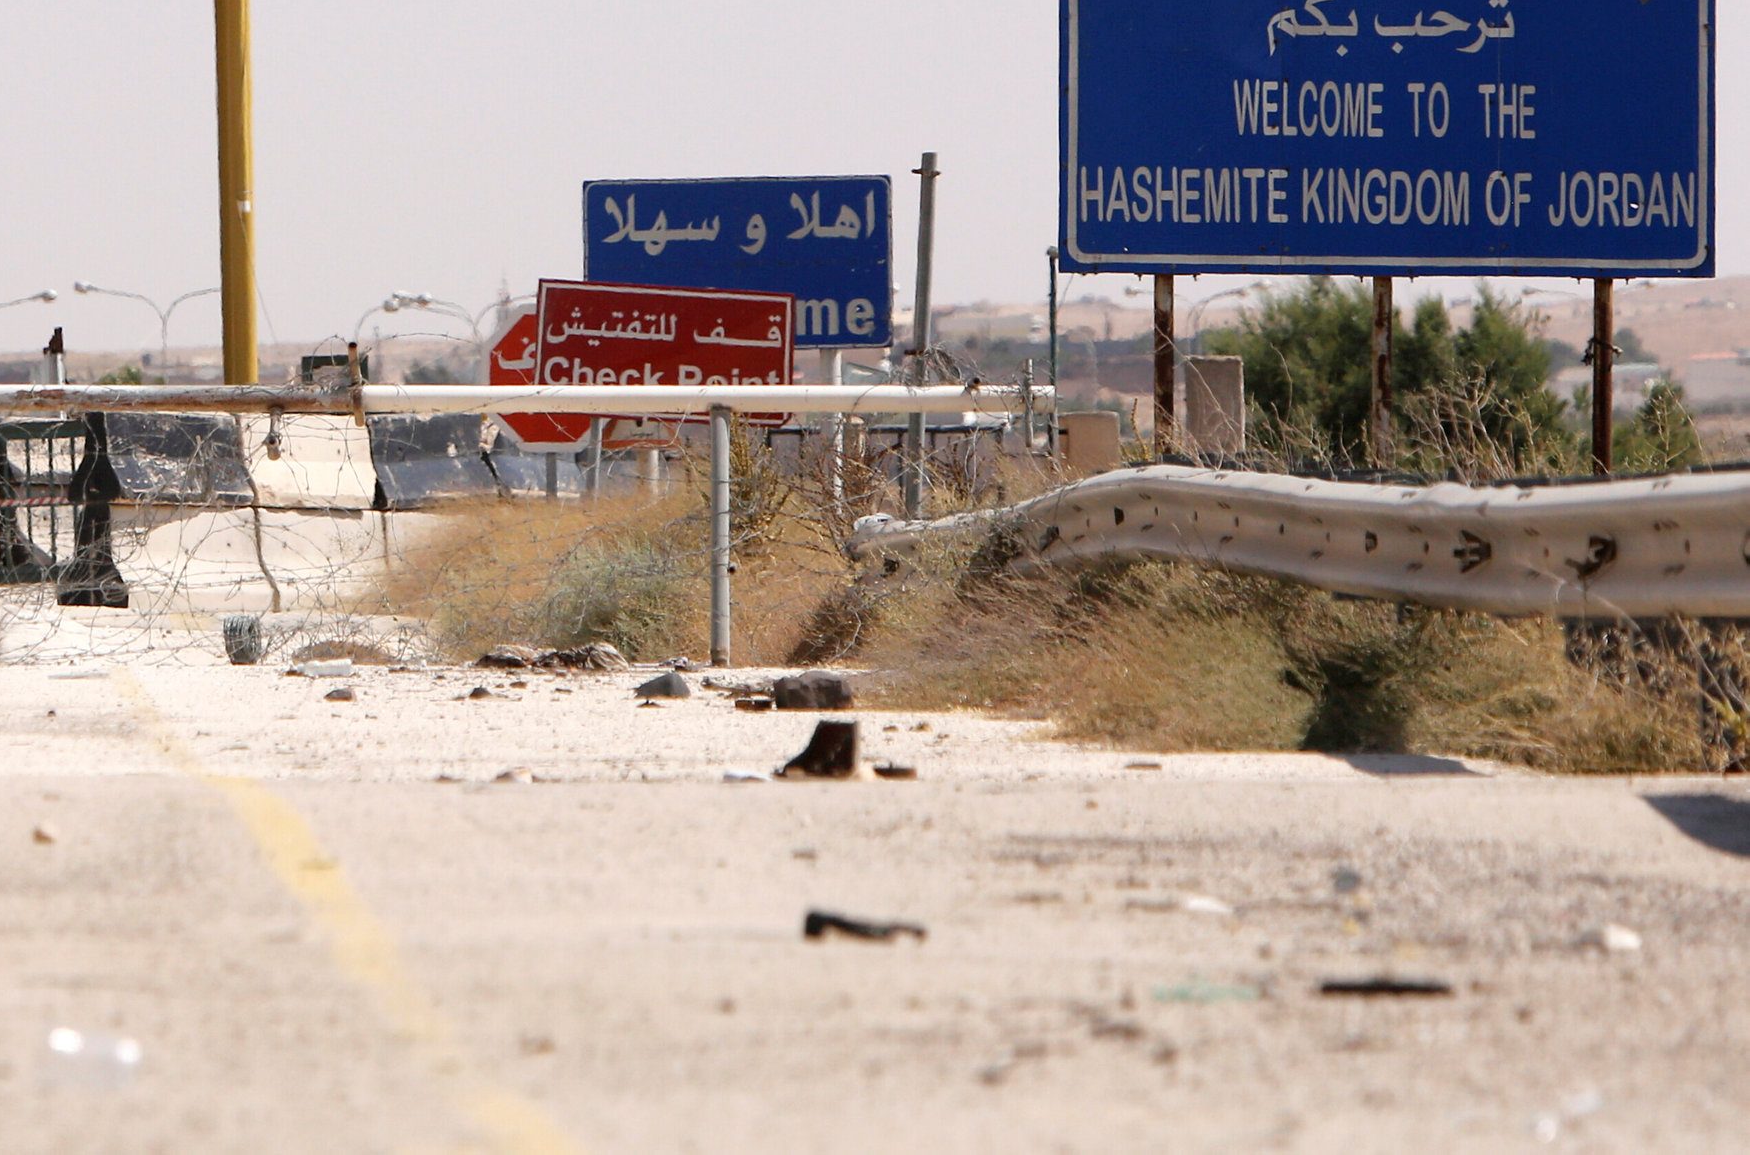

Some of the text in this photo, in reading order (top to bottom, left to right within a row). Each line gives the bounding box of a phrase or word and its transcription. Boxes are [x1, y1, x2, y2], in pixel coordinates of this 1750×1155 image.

[1233, 79, 1536, 139] WELCOME TO THE
[1080, 166, 1696, 228] HASHEMITE KINGDOM OF JORDAN
[601, 190, 875, 256] اهلا و سهلا
[546, 307, 678, 347] للتفتيش
[693, 314, 783, 348] قف
[497, 336, 536, 370] ف
